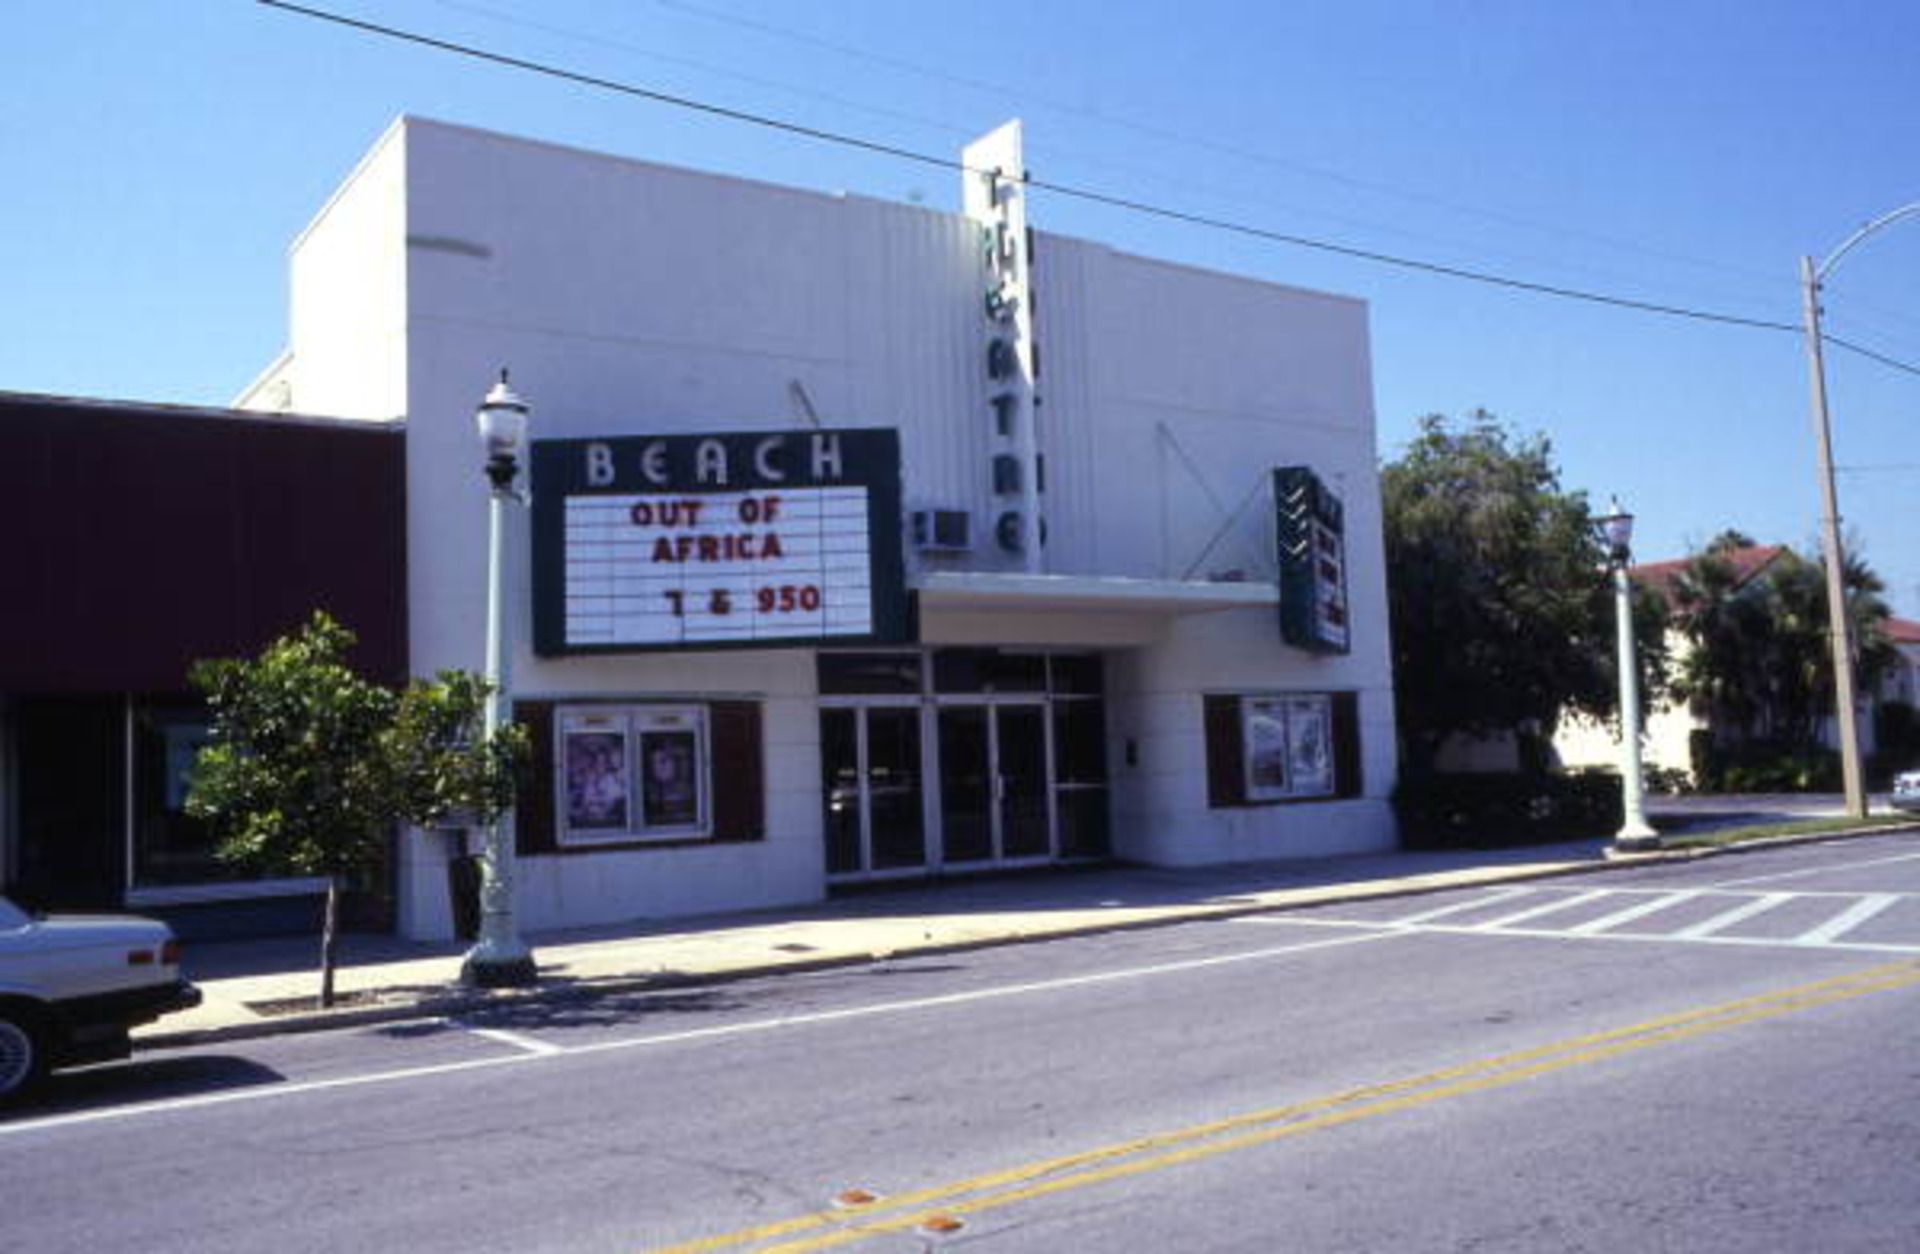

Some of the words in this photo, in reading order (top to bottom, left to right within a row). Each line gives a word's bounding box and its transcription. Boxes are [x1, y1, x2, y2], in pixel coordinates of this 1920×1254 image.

[587, 434, 842, 485] BEACH
[631, 501, 703, 526] OUT
[740, 498, 782, 524] OF
[653, 534, 782, 562] AFRICA
[665, 590, 684, 616] 7
[710, 588, 731, 615] &
[757, 586, 819, 612] 950
